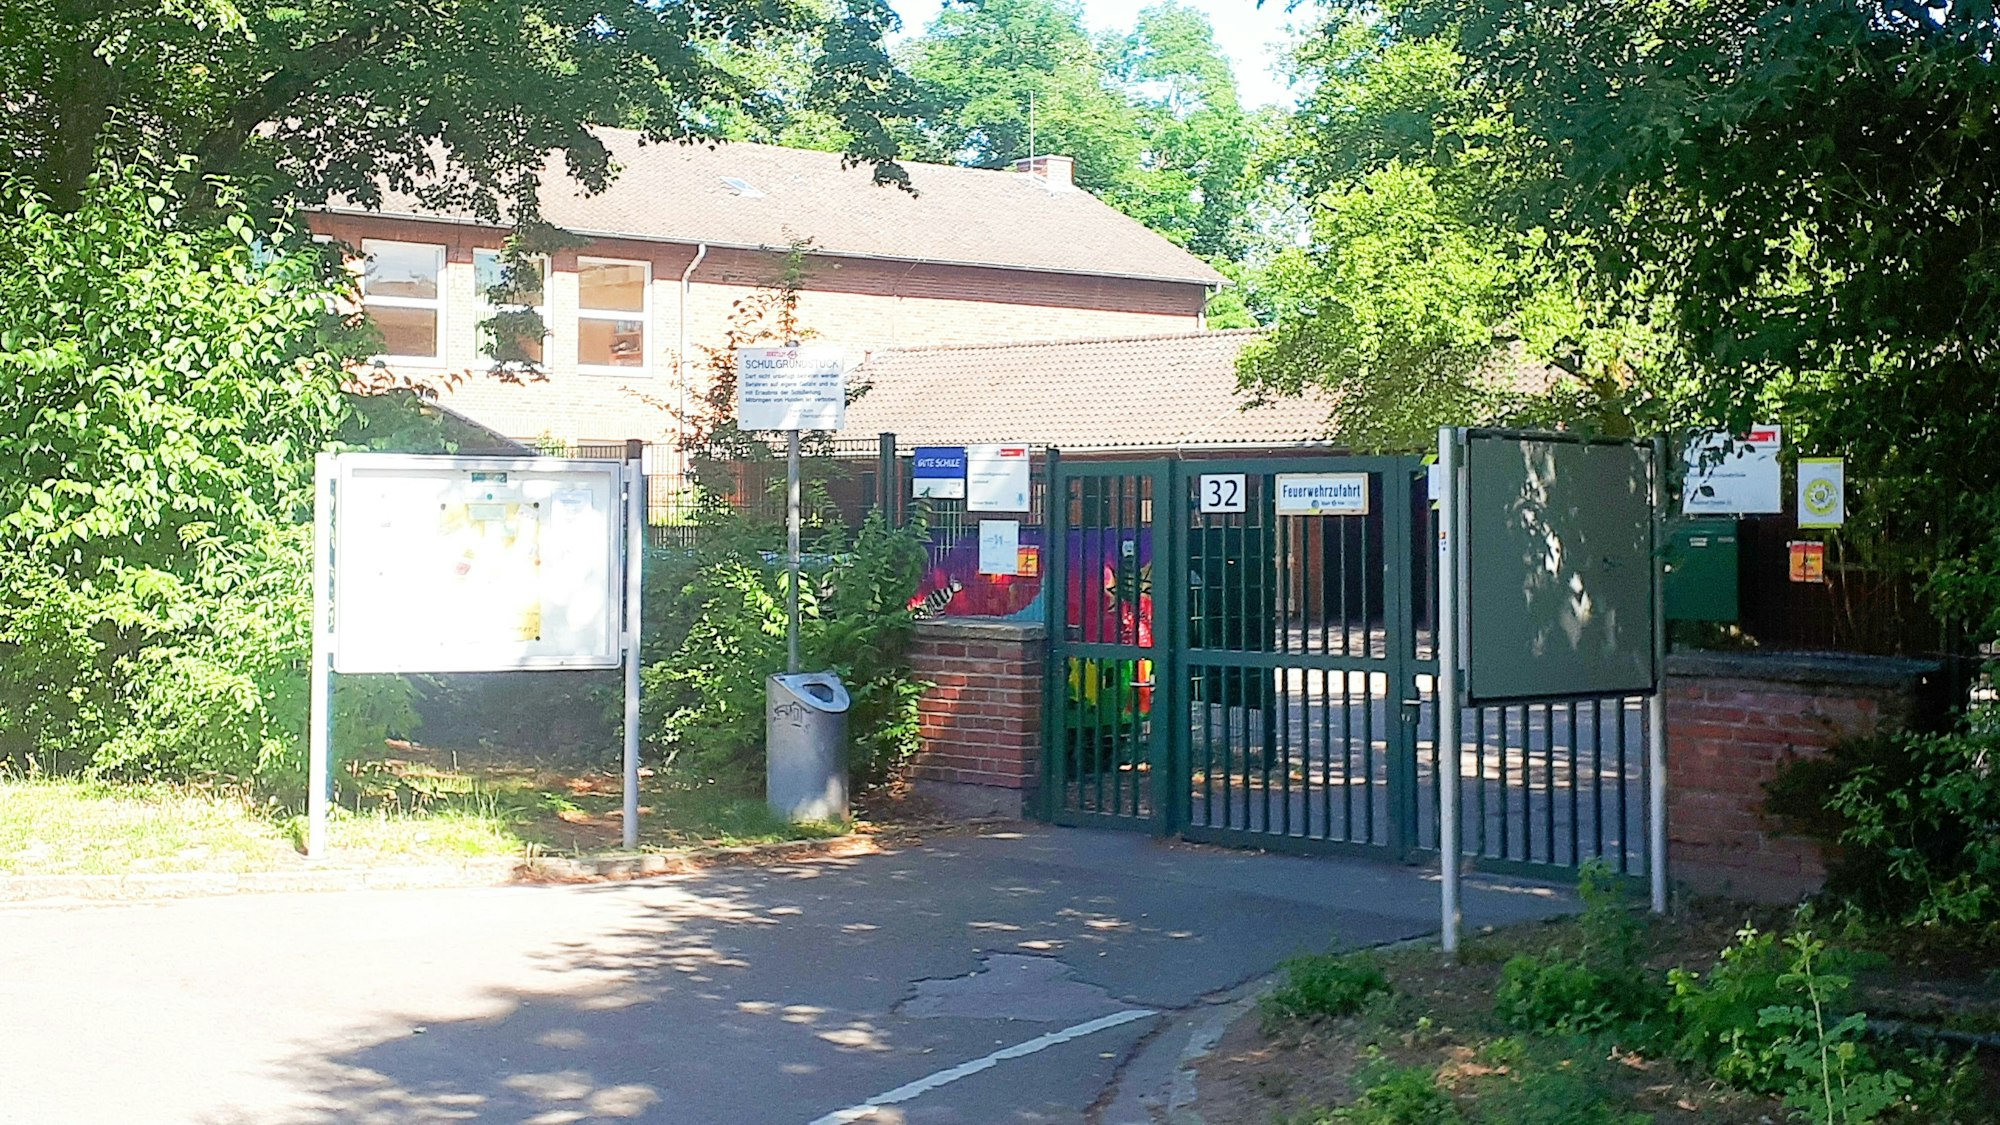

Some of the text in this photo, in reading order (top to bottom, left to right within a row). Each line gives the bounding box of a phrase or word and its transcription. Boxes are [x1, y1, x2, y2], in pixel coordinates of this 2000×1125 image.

[917, 458, 961, 468] GUTE SCHULE
[1208, 479, 1238, 507] 32
[1282, 484, 1361, 498] Feuerwehrzufahrt
